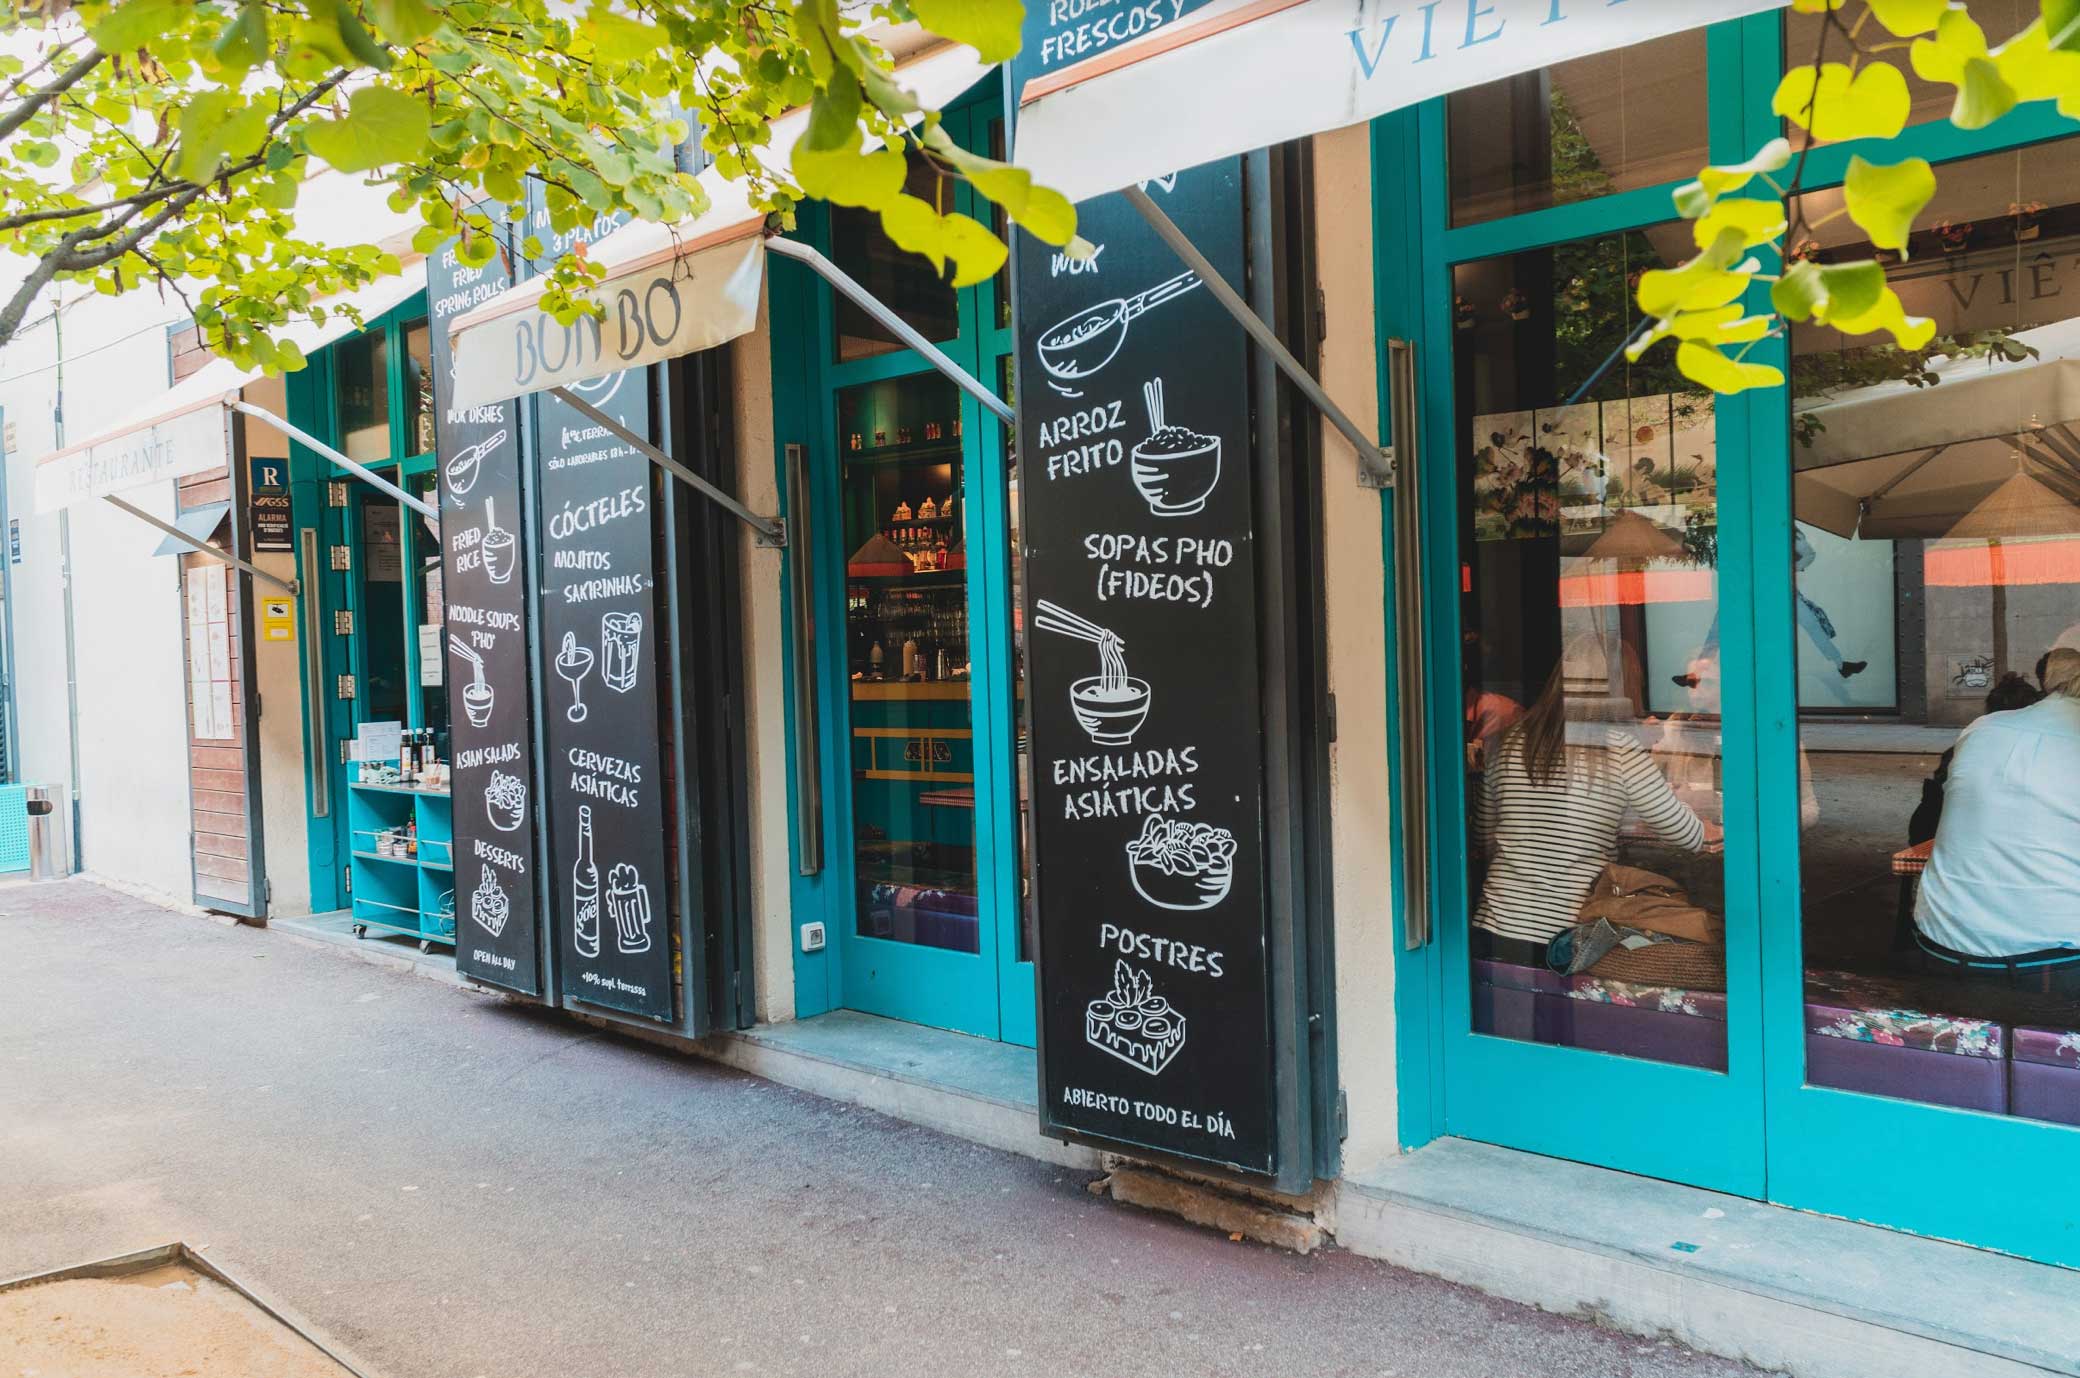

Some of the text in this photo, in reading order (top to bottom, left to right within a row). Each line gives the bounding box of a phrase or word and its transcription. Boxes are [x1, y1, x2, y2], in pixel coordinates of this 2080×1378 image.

[1040, 0, 1163, 65] FRESCOS
[452, 266, 483, 288] FRIED
[1050, 243, 1105, 278] WOK
[435, 277, 505, 318] SPRING ROLLS
[616, 277, 682, 361] BO
[468, 405, 505, 424] DISHES
[1039, 400, 1127, 449] ARROZ
[262, 467, 280, 486] R
[1047, 439, 1124, 481] FRITO
[549, 485, 646, 540] CÓCTELES
[452, 527, 481, 551] FRIED
[1083, 533, 1233, 567] SOPAS PHO
[456, 550, 482, 573] RICE
[554, 549, 611, 571] MOJITOS
[563, 573, 642, 604] SAKIRINHAS
[1097, 563, 1214, 609] (FIDEOS)
[448, 604, 521, 632] NOODLE SOUPS
[456, 743, 521, 769] ASIAN SALADS
[568, 748, 641, 784] CERVEZAS
[1053, 746, 1199, 785] ENSALADAS
[570, 772, 639, 808] ASIÁTICAS
[1064, 781, 1197, 821] ASIÁTICAS
[474, 839, 526, 874] DESSERTS
[473, 949, 516, 971] OPEN ALL DAY
[1100, 923, 1224, 978] POSTRES
[1063, 1086, 1236, 1140] ABIERTO TODO EL DÍA
